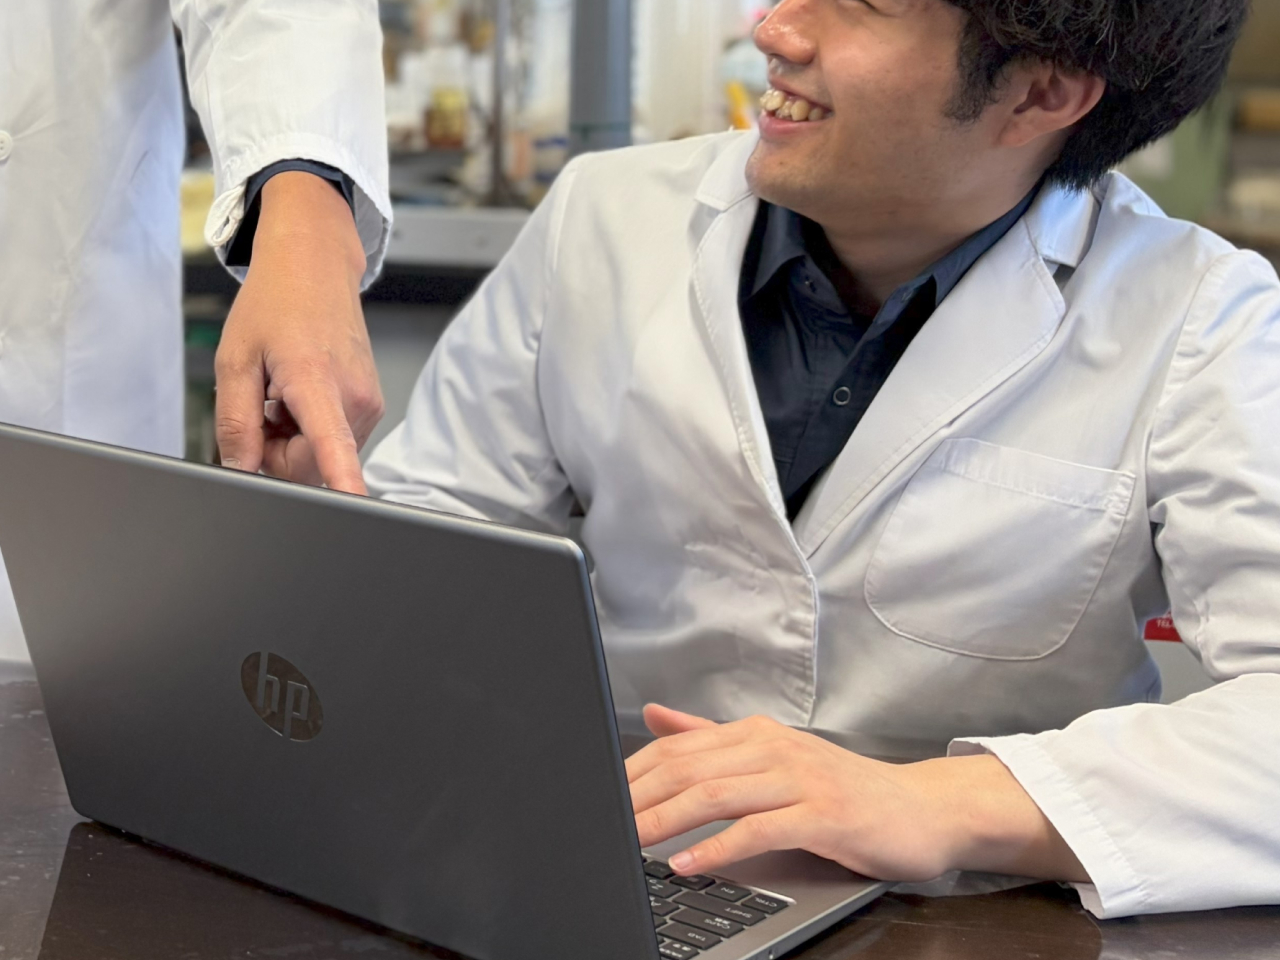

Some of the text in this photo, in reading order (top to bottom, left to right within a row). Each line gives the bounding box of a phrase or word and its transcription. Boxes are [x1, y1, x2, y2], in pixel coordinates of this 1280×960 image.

[257, 652, 310, 740] hp
[754, 897, 778, 907] CTRL
[725, 907, 753, 919] SHIFT
[704, 918, 730, 930] CAPS
[687, 932, 706, 941] TAB
